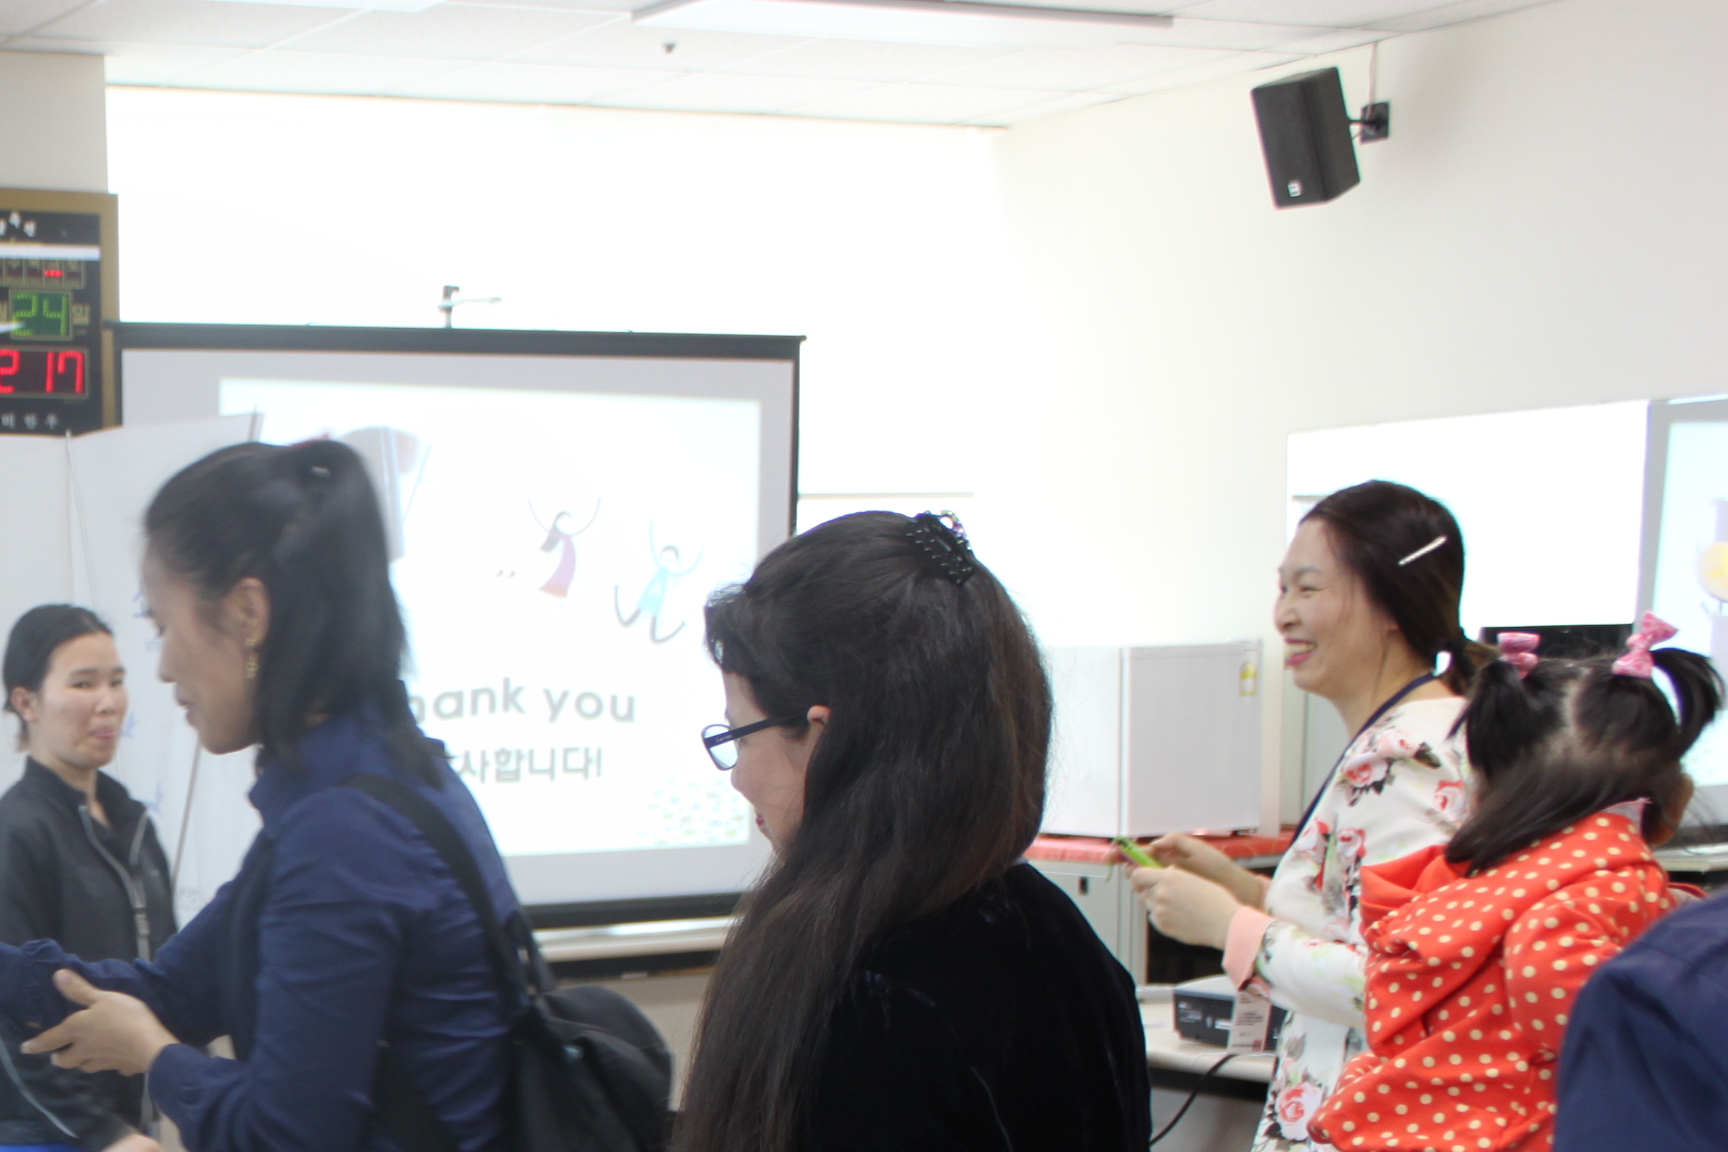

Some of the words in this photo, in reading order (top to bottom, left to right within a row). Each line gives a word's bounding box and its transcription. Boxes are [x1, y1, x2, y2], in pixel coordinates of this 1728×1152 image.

[12, 292, 69, 337] 24
[543, 686, 636, 723] you
[457, 746, 603, 784] 사합니다!
